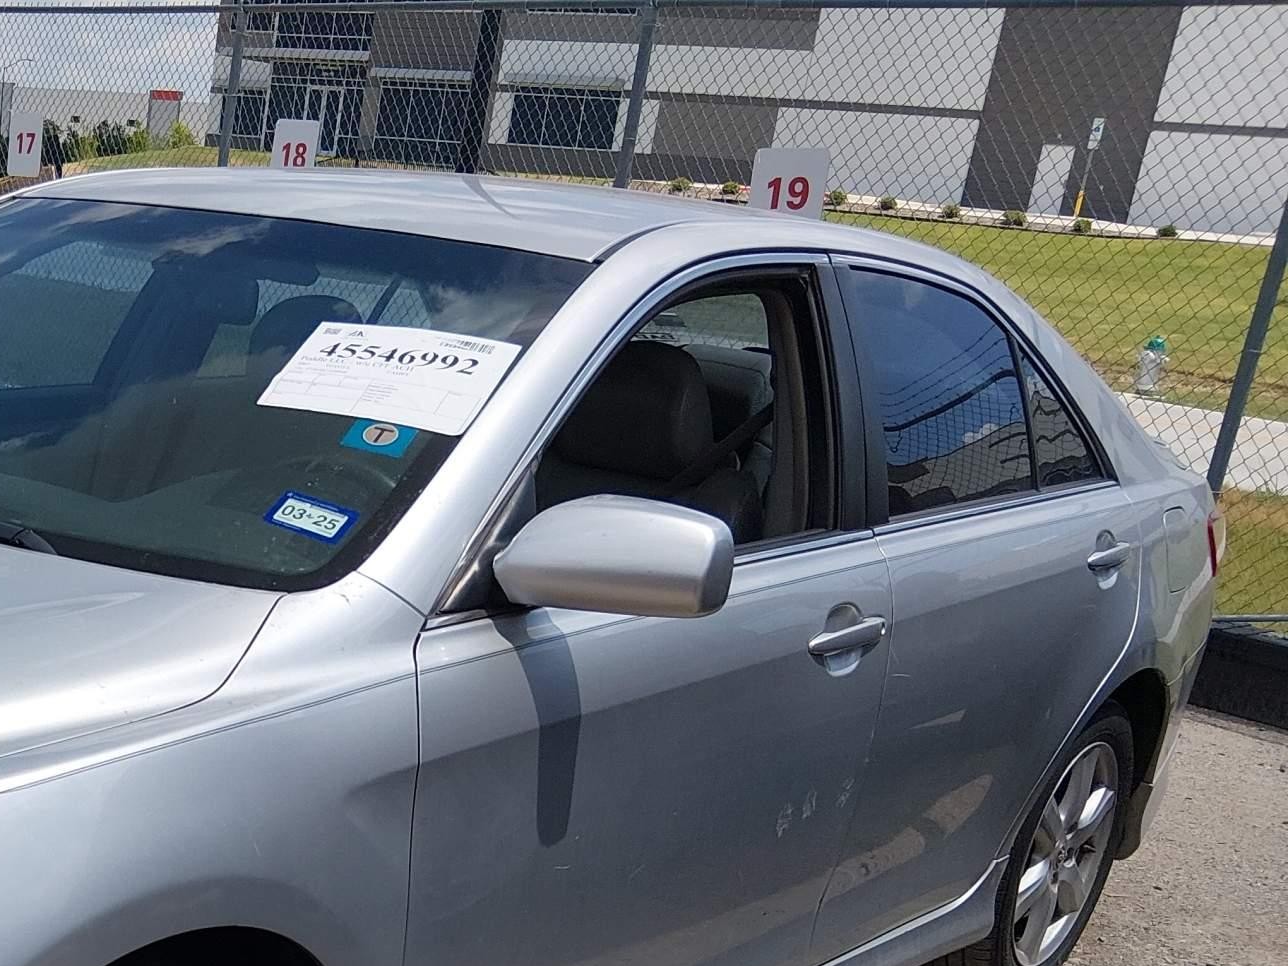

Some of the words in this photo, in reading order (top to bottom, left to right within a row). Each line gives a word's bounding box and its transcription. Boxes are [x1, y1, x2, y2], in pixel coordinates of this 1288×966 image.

[15, 132, 36, 154] 17
[281, 142, 308, 167] 18
[767, 176, 810, 210] 19
[319, 341, 480, 376] 45546992
[281, 504, 308, 520] 03
[312, 514, 340, 530] 25
